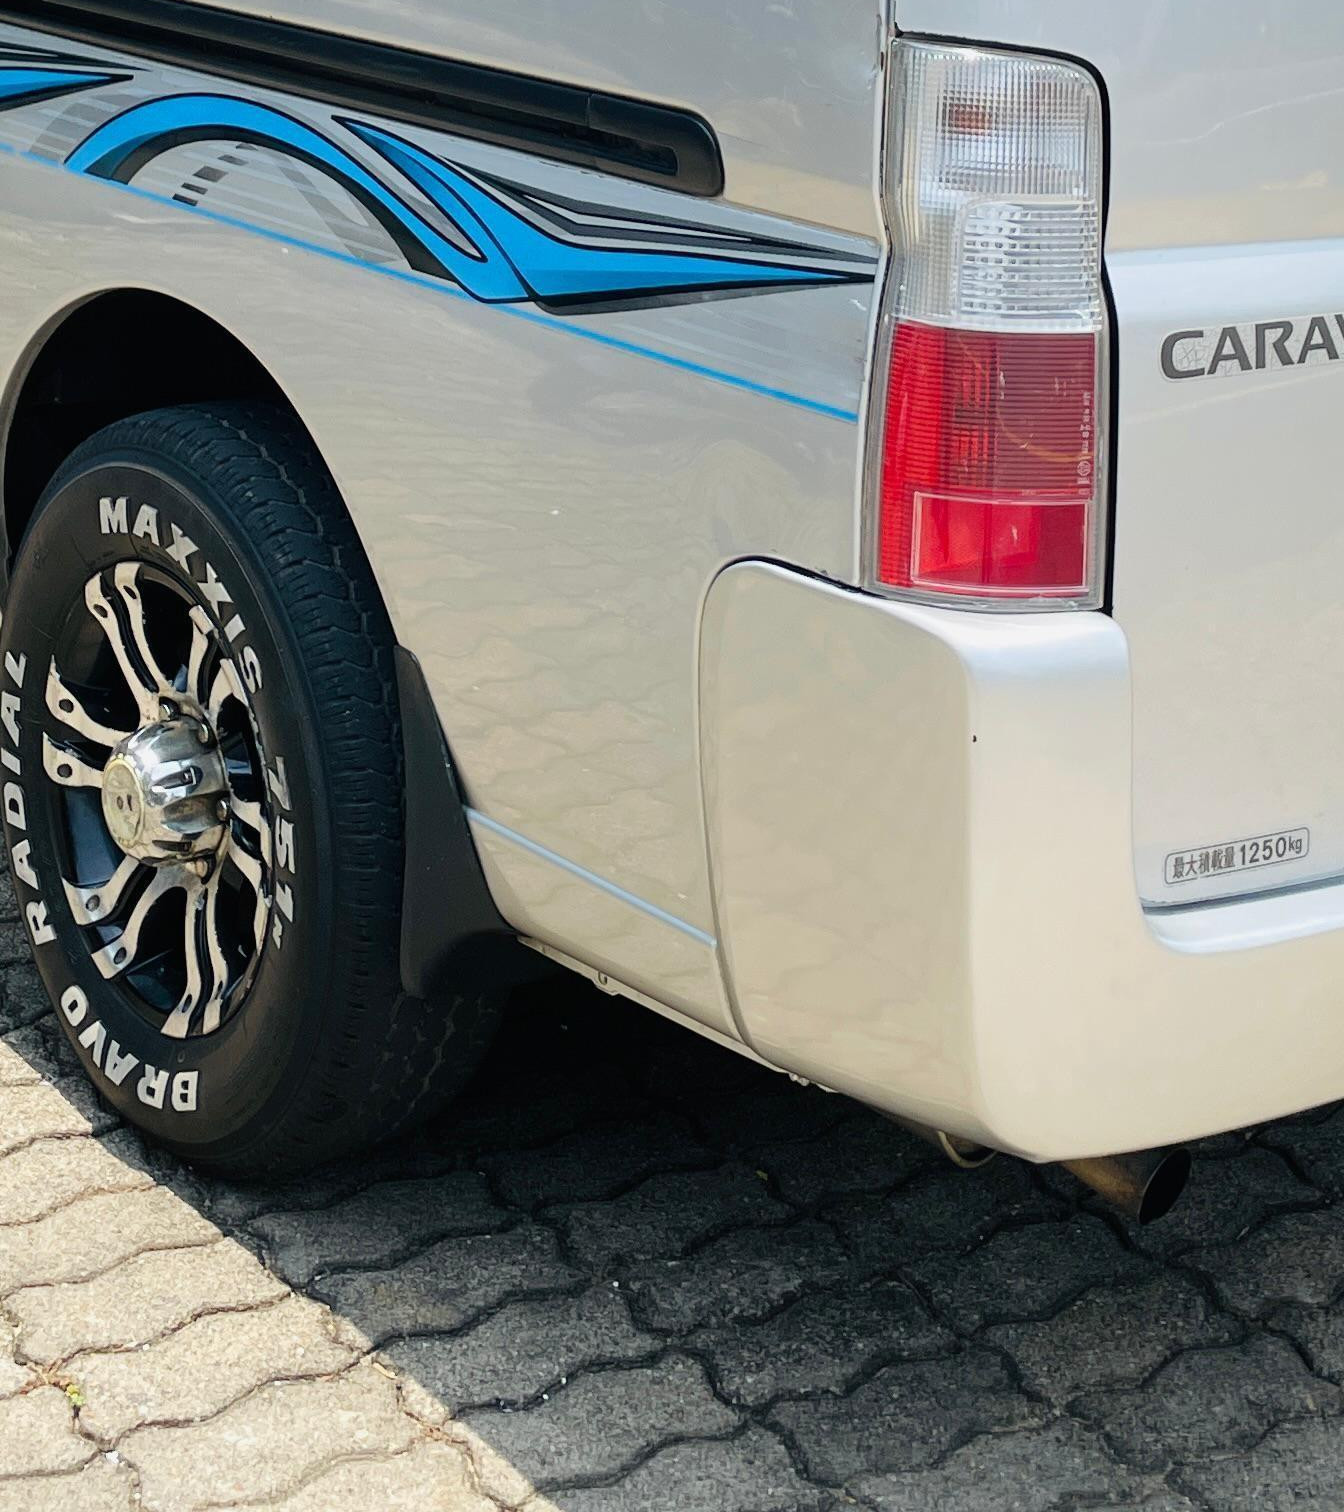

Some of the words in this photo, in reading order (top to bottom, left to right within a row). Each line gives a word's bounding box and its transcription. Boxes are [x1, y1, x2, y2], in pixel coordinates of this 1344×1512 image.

[99, 496, 264, 695] MAXXIS
[0, 649, 59, 948] RADIAL
[1172, 846, 1236, 879] 最大積載量
[1239, 836, 1303, 866] 1250kg
[60, 984, 199, 1114] BRAVO
